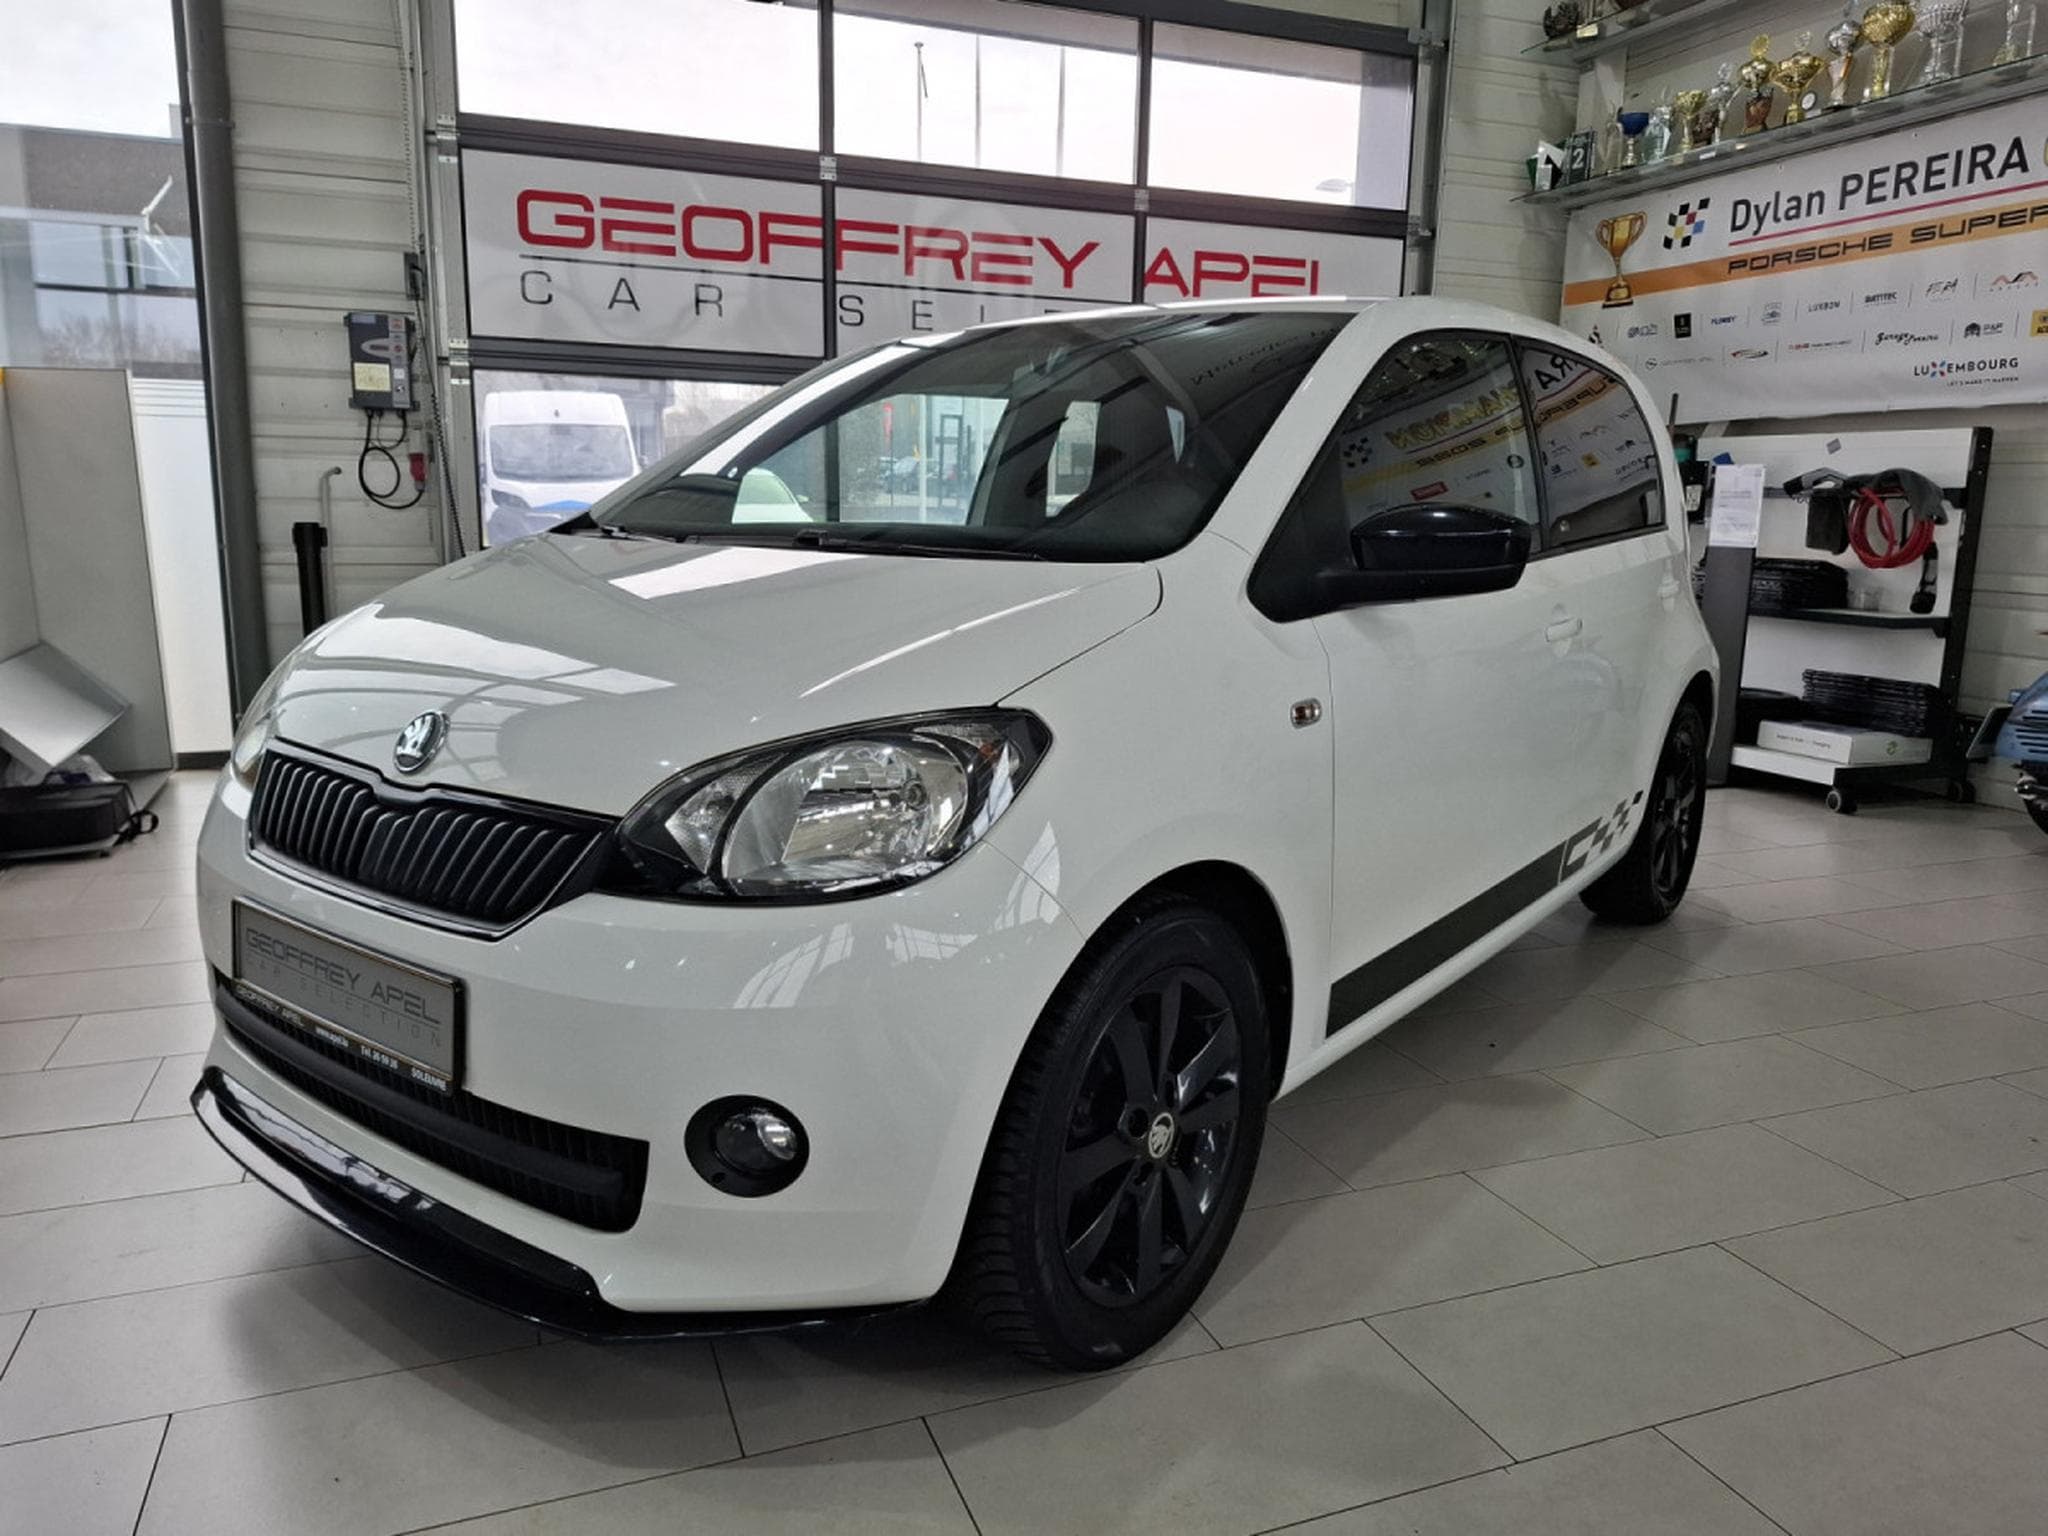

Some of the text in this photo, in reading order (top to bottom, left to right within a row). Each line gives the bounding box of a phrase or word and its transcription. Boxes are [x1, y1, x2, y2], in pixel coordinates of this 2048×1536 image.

[1573, 148, 1585, 170] 2
[1730, 136, 2030, 236] Dylan PEREIRA
[516, 189, 1100, 289] GEOFFREY
[1727, 232, 1894, 275] PORSCHE
[520, 270, 723, 318] CAR
[1914, 357, 2019, 378] LUXEMBOURG
[246, 927, 442, 1025] GEOFFREY APEL
